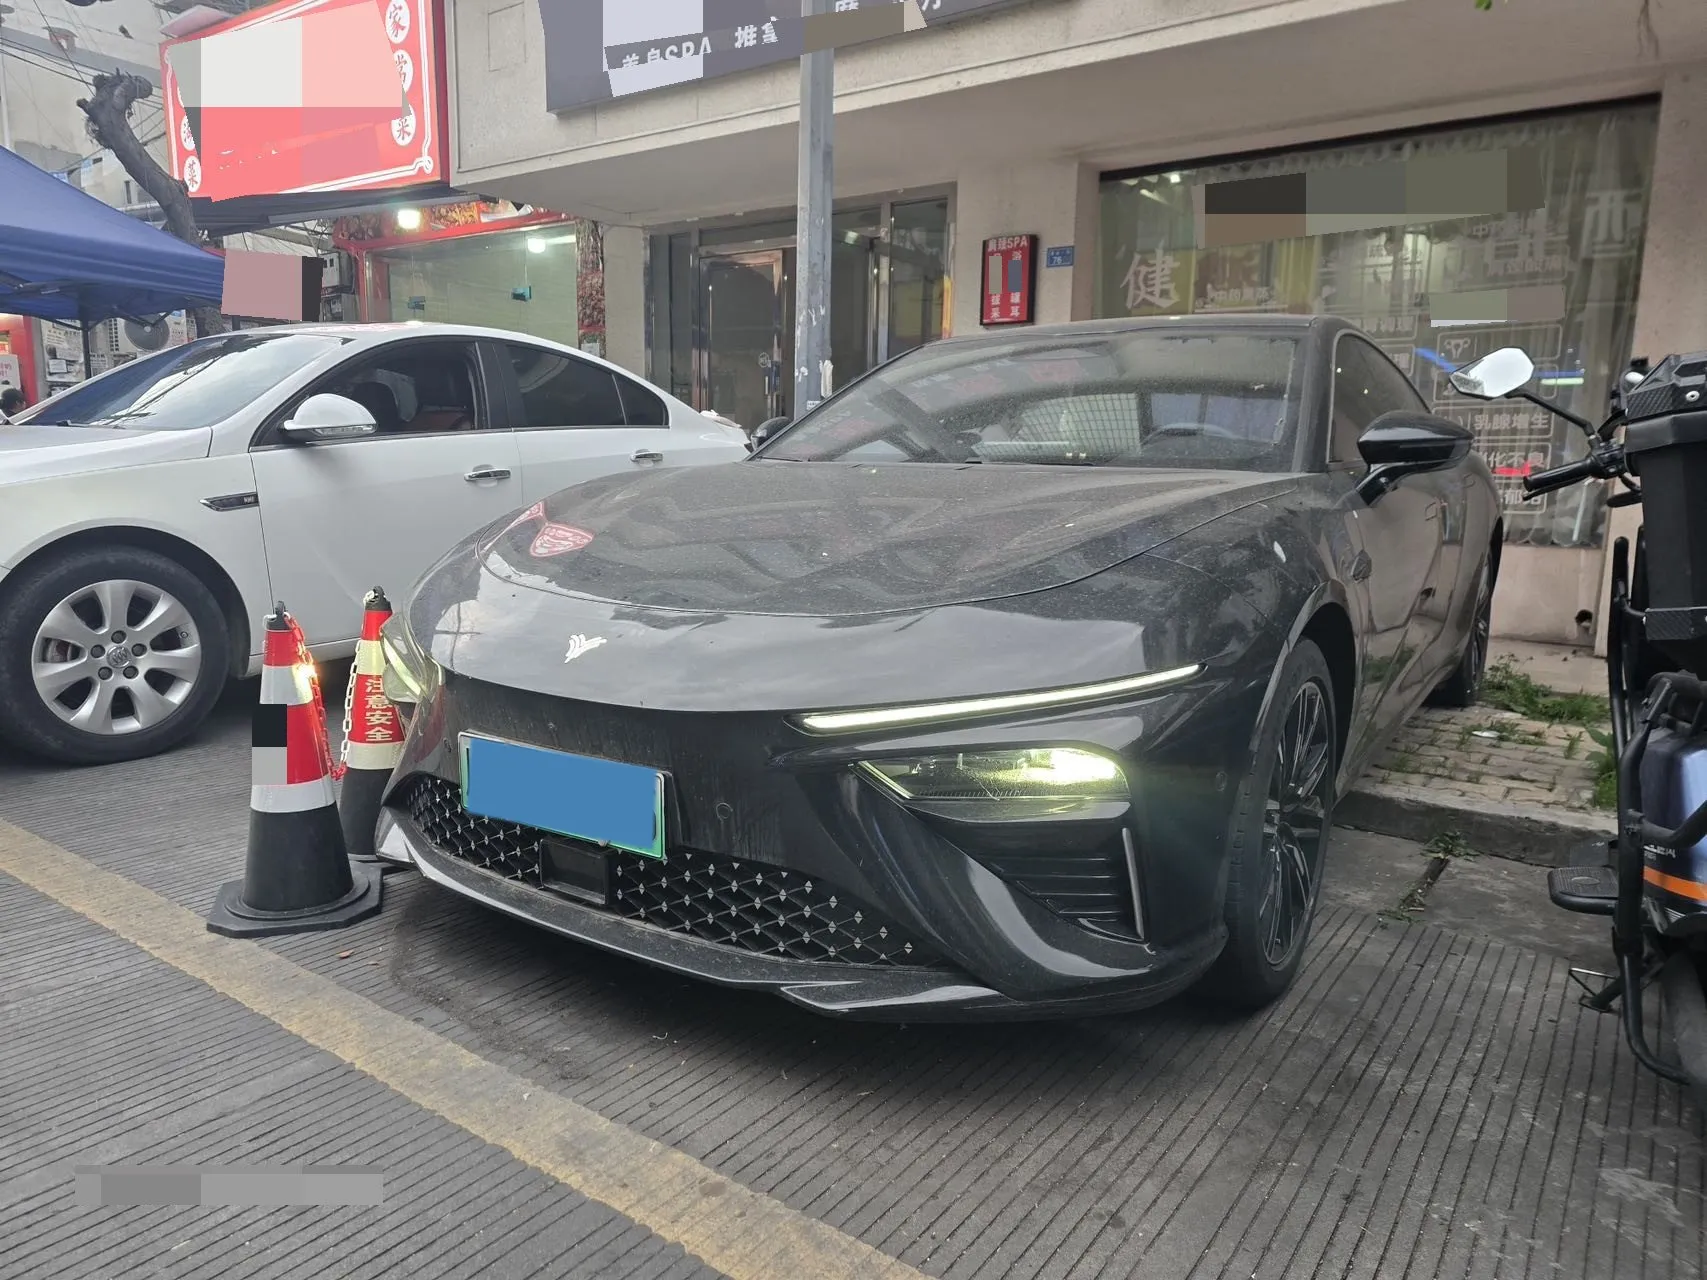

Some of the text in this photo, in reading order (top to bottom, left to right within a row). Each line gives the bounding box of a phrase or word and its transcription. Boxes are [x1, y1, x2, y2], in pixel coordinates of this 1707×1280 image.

[1473, 412, 1550, 430] 乳腺增生
[364, 678, 393, 742] 注意安全
